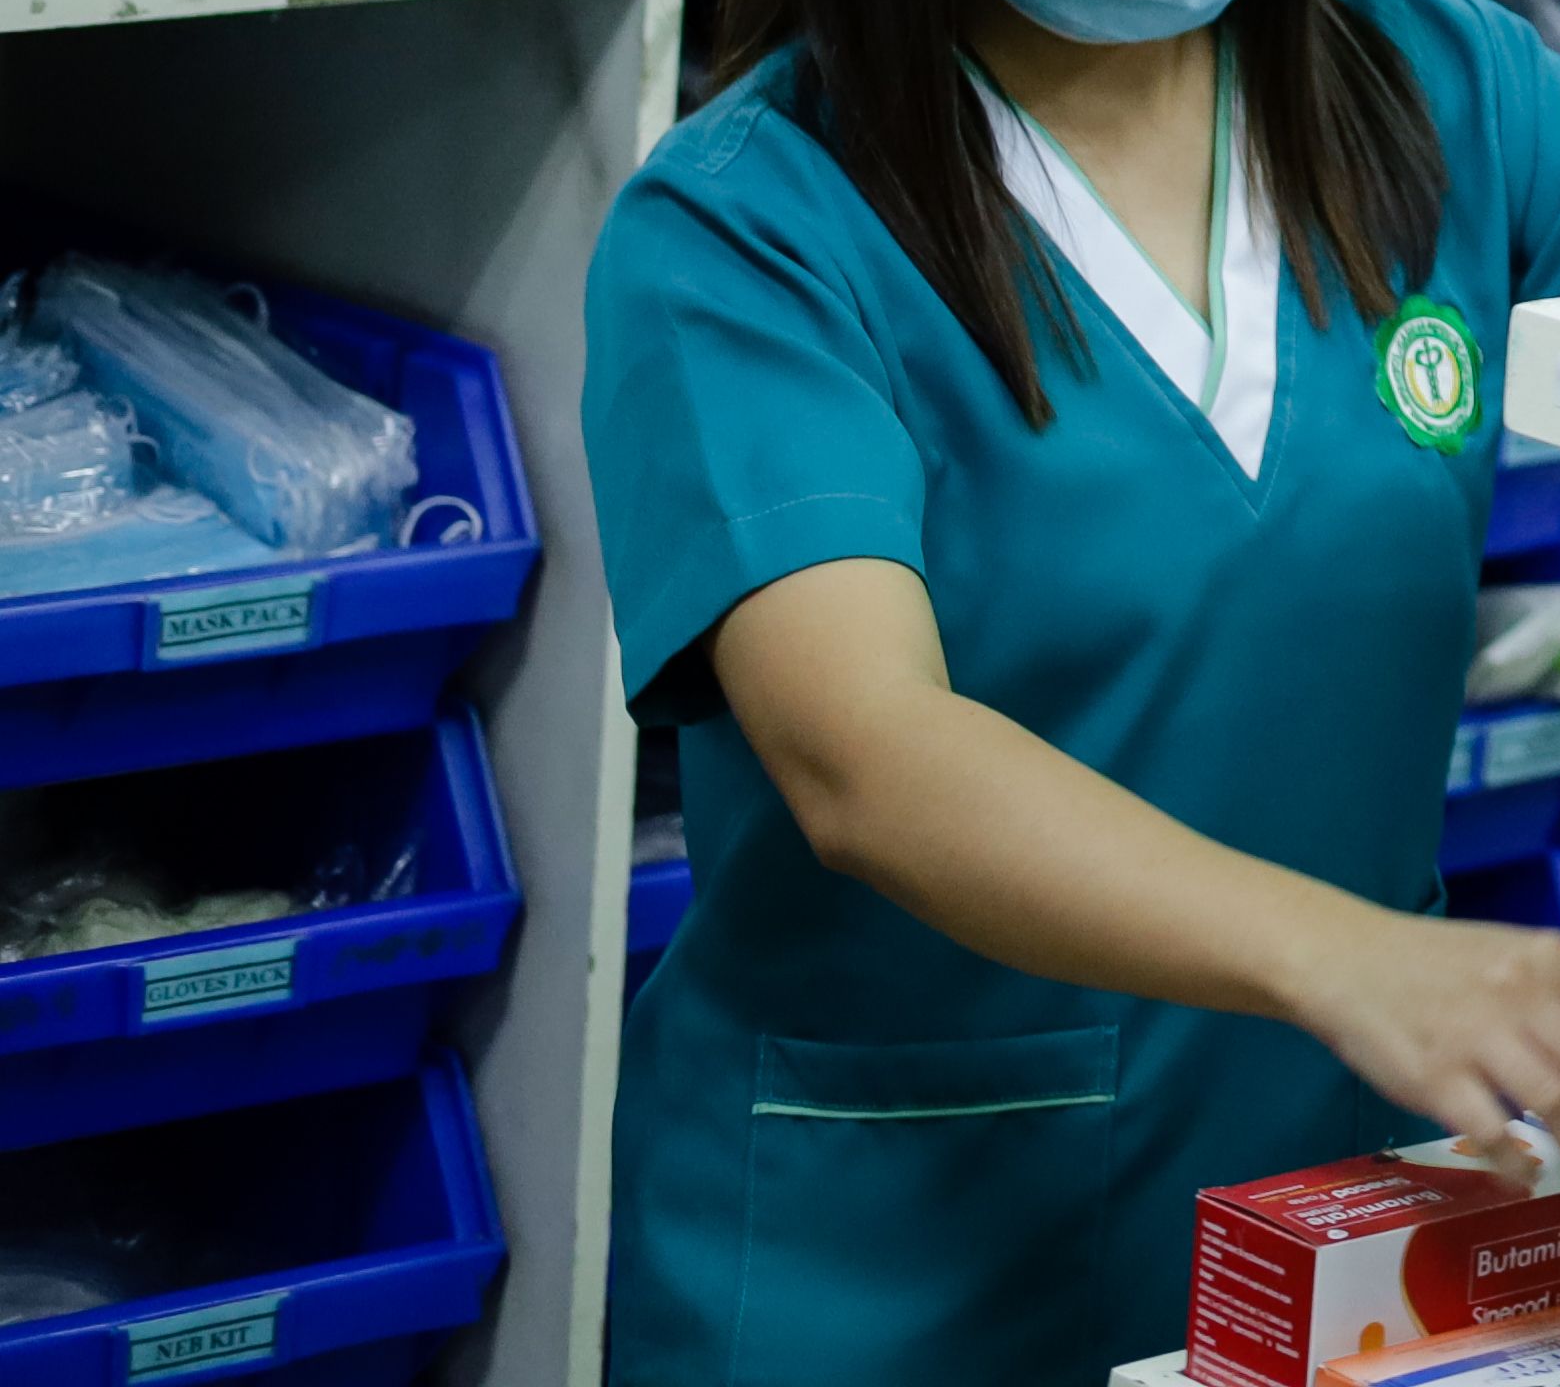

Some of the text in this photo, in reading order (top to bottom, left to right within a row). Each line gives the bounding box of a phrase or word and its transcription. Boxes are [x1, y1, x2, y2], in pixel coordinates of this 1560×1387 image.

[169, 606, 302, 637] MASK PACK
[148, 968, 287, 1003] GLOVES PACK
[1333, 1176, 1411, 1198] Sinecod
[1306, 1190, 1443, 1227] Butamirate
[1473, 1291, 1551, 1325] Sinecod
[156, 1327, 251, 1361] NEB KIT
